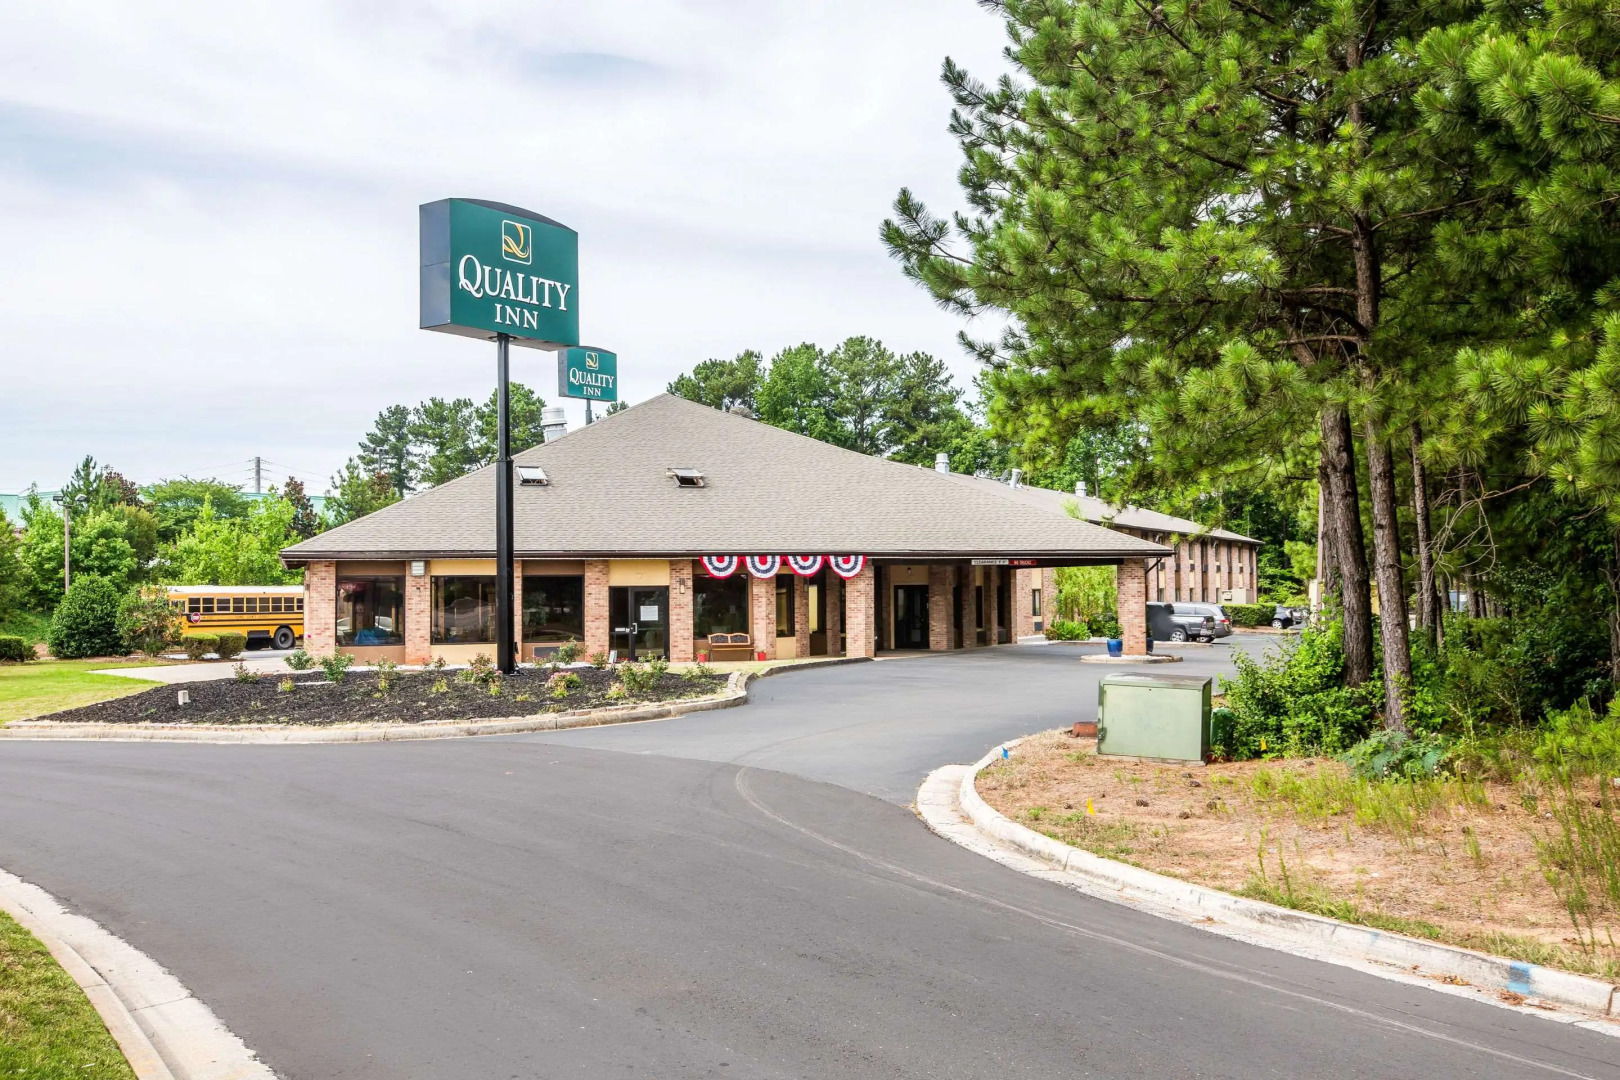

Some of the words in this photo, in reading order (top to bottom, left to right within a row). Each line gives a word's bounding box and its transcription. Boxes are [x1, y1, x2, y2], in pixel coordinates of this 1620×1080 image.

[458, 254, 570, 311] QUALITY
[495, 303, 539, 330] INN
[570, 367, 614, 388] QUALITY
[583, 386, 601, 396] INN
